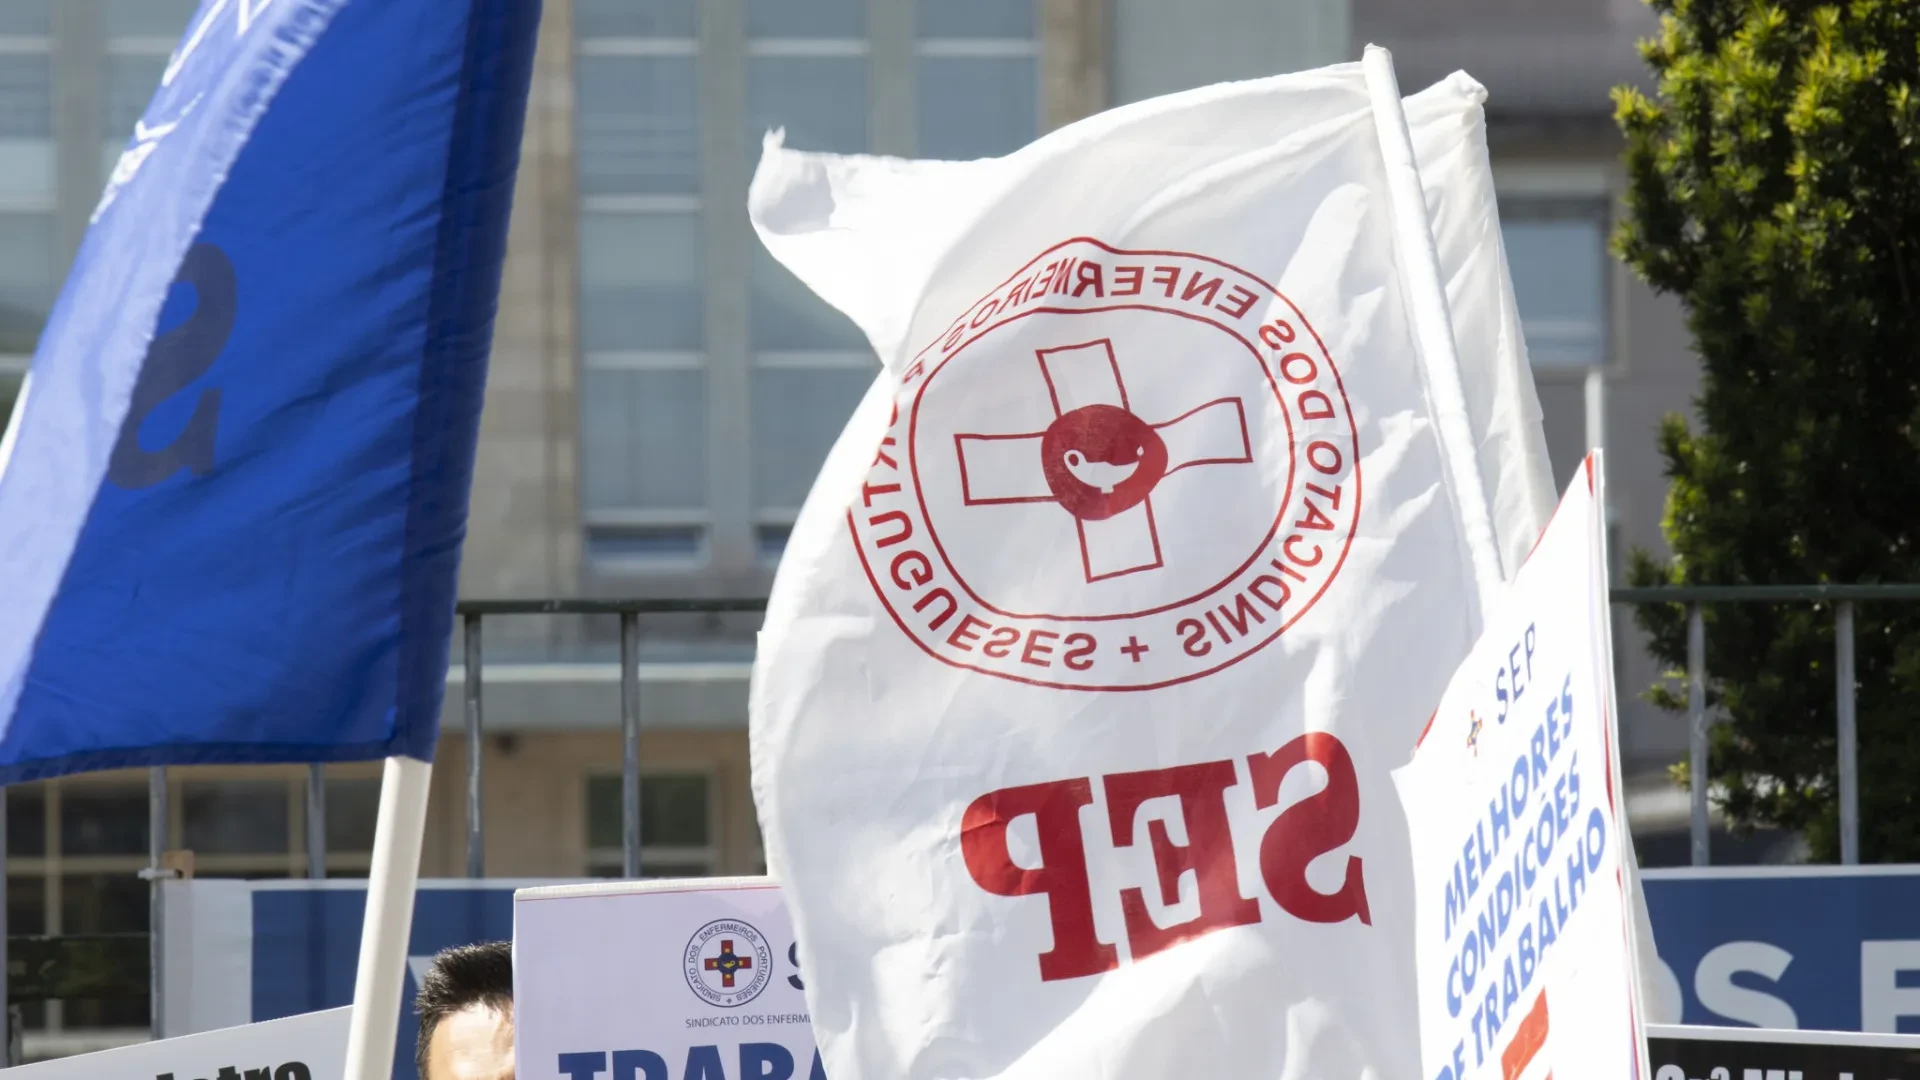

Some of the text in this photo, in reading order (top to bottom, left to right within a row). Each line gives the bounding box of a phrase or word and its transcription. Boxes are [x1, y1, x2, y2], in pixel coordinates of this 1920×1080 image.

[1496, 621, 1536, 725] SEP
[1444, 672, 1574, 943] MELHORES
[688, 944, 700, 963] DOS
[699, 923, 759, 942] ENFERMEIROS
[1434, 806, 1606, 1080] E TRABALHO
[688, 967, 721, 1002] SINDICATO
[735, 945, 768, 1002] PORTUGUESES
[685, 1013, 811, 1029] SINDICATO DOS ENFERM
